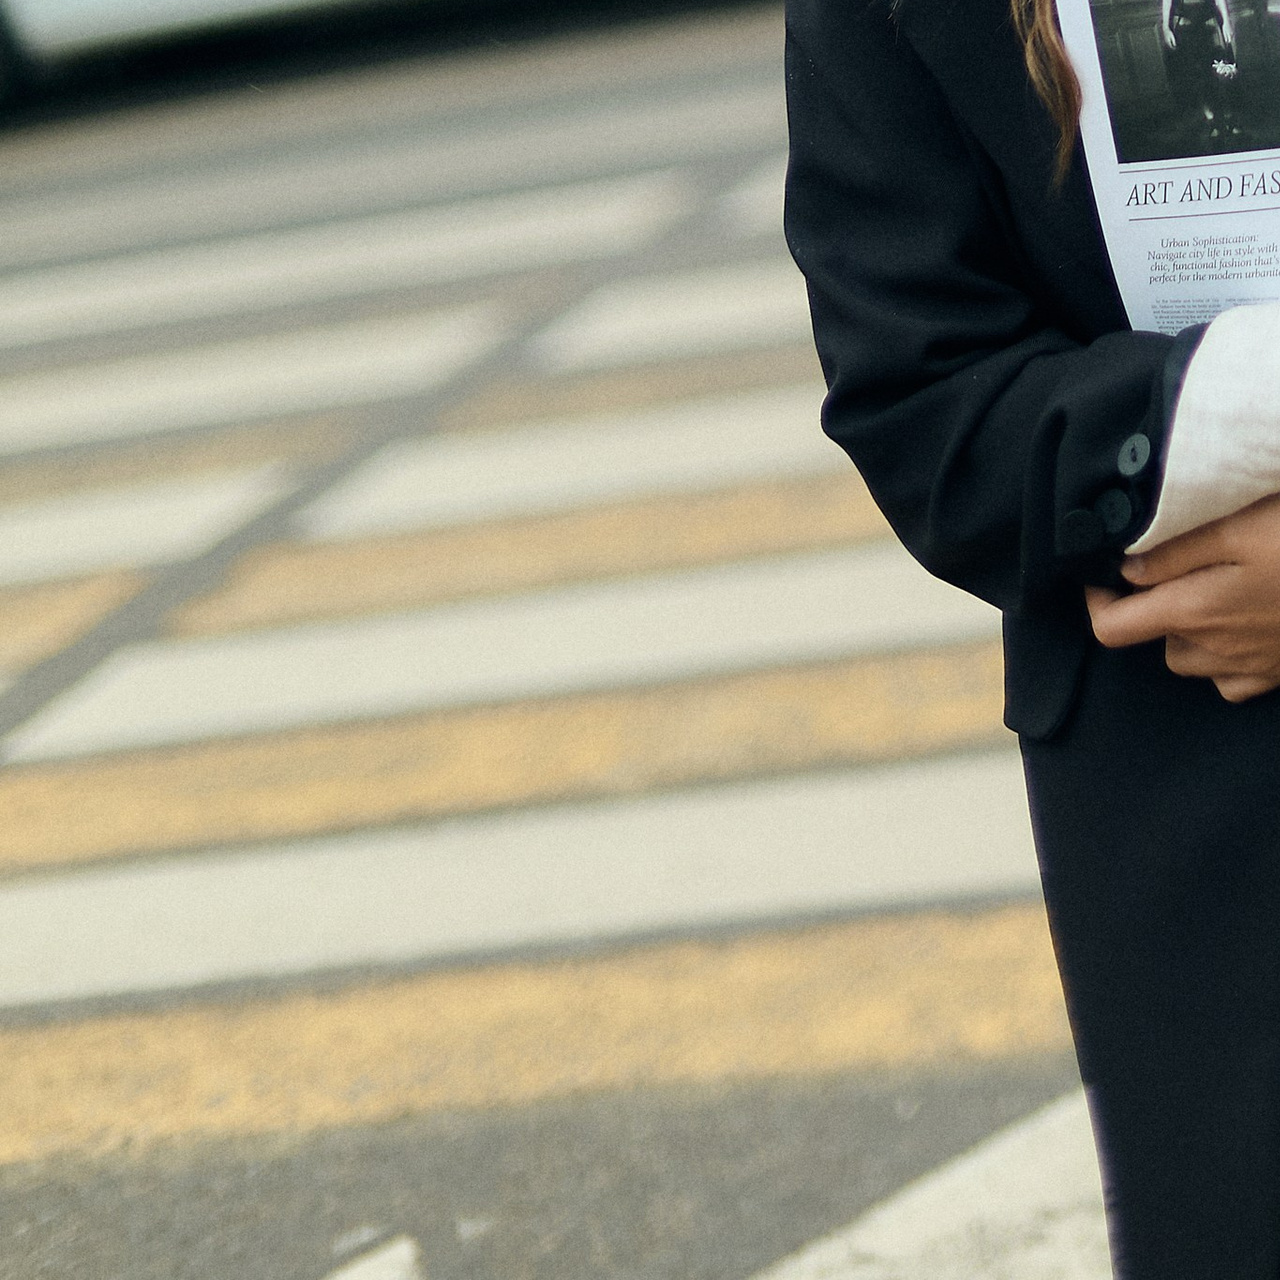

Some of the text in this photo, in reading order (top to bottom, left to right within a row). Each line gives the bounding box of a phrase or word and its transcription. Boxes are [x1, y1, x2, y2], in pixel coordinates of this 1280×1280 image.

[1125, 181, 1174, 207] ART
[1179, 176, 1233, 203] AND
[1161, 234, 1259, 249] Urban Sophistication:
[1147, 242, 1278, 261] Navigate city life in style with
[1150, 255, 1280, 273] chic, functional fashion that's
[1149, 272, 1176, 285] perfect
[1177, 271, 1191, 284] for
[1193, 272, 1206, 281] the
[1207, 270, 1243, 282] modern
